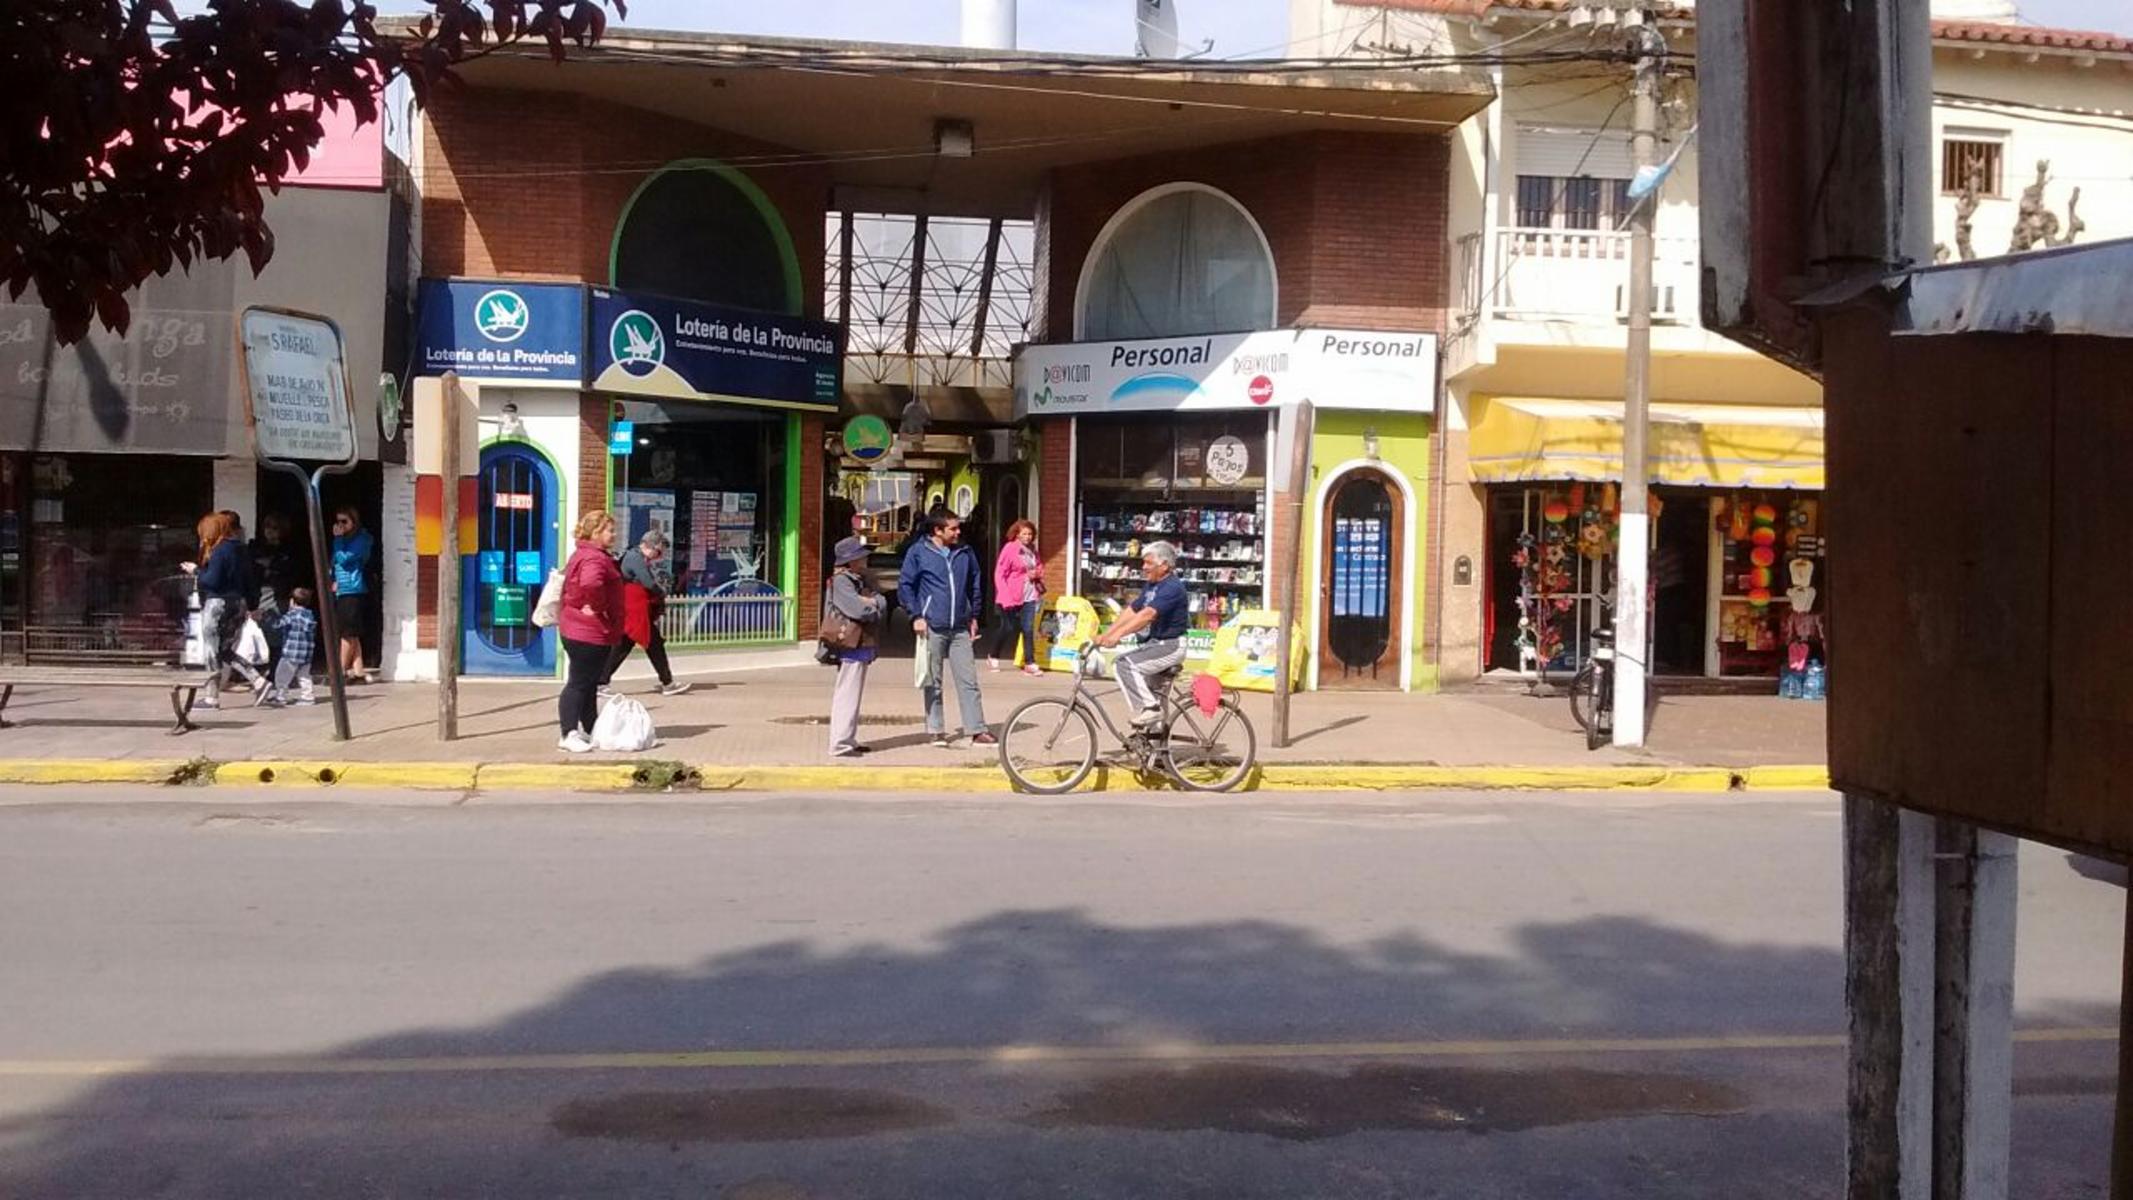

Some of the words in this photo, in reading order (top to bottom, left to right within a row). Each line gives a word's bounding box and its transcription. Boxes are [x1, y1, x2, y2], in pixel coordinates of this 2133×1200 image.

[675, 313, 728, 341] Lotería
[732, 321, 751, 343] de
[752, 325, 768, 346] la
[771, 328, 834, 354] Provincia
[426, 346, 474, 362] Lotería
[477, 350, 494, 362] de
[496, 350, 511, 363] la
[513, 349, 577, 366] Provincia
[1110, 339, 1213, 368] Personal
[1321, 335, 1424, 358] Personal
[1225, 441, 1234, 457] 5
[495, 493, 533, 509] ABERTO
